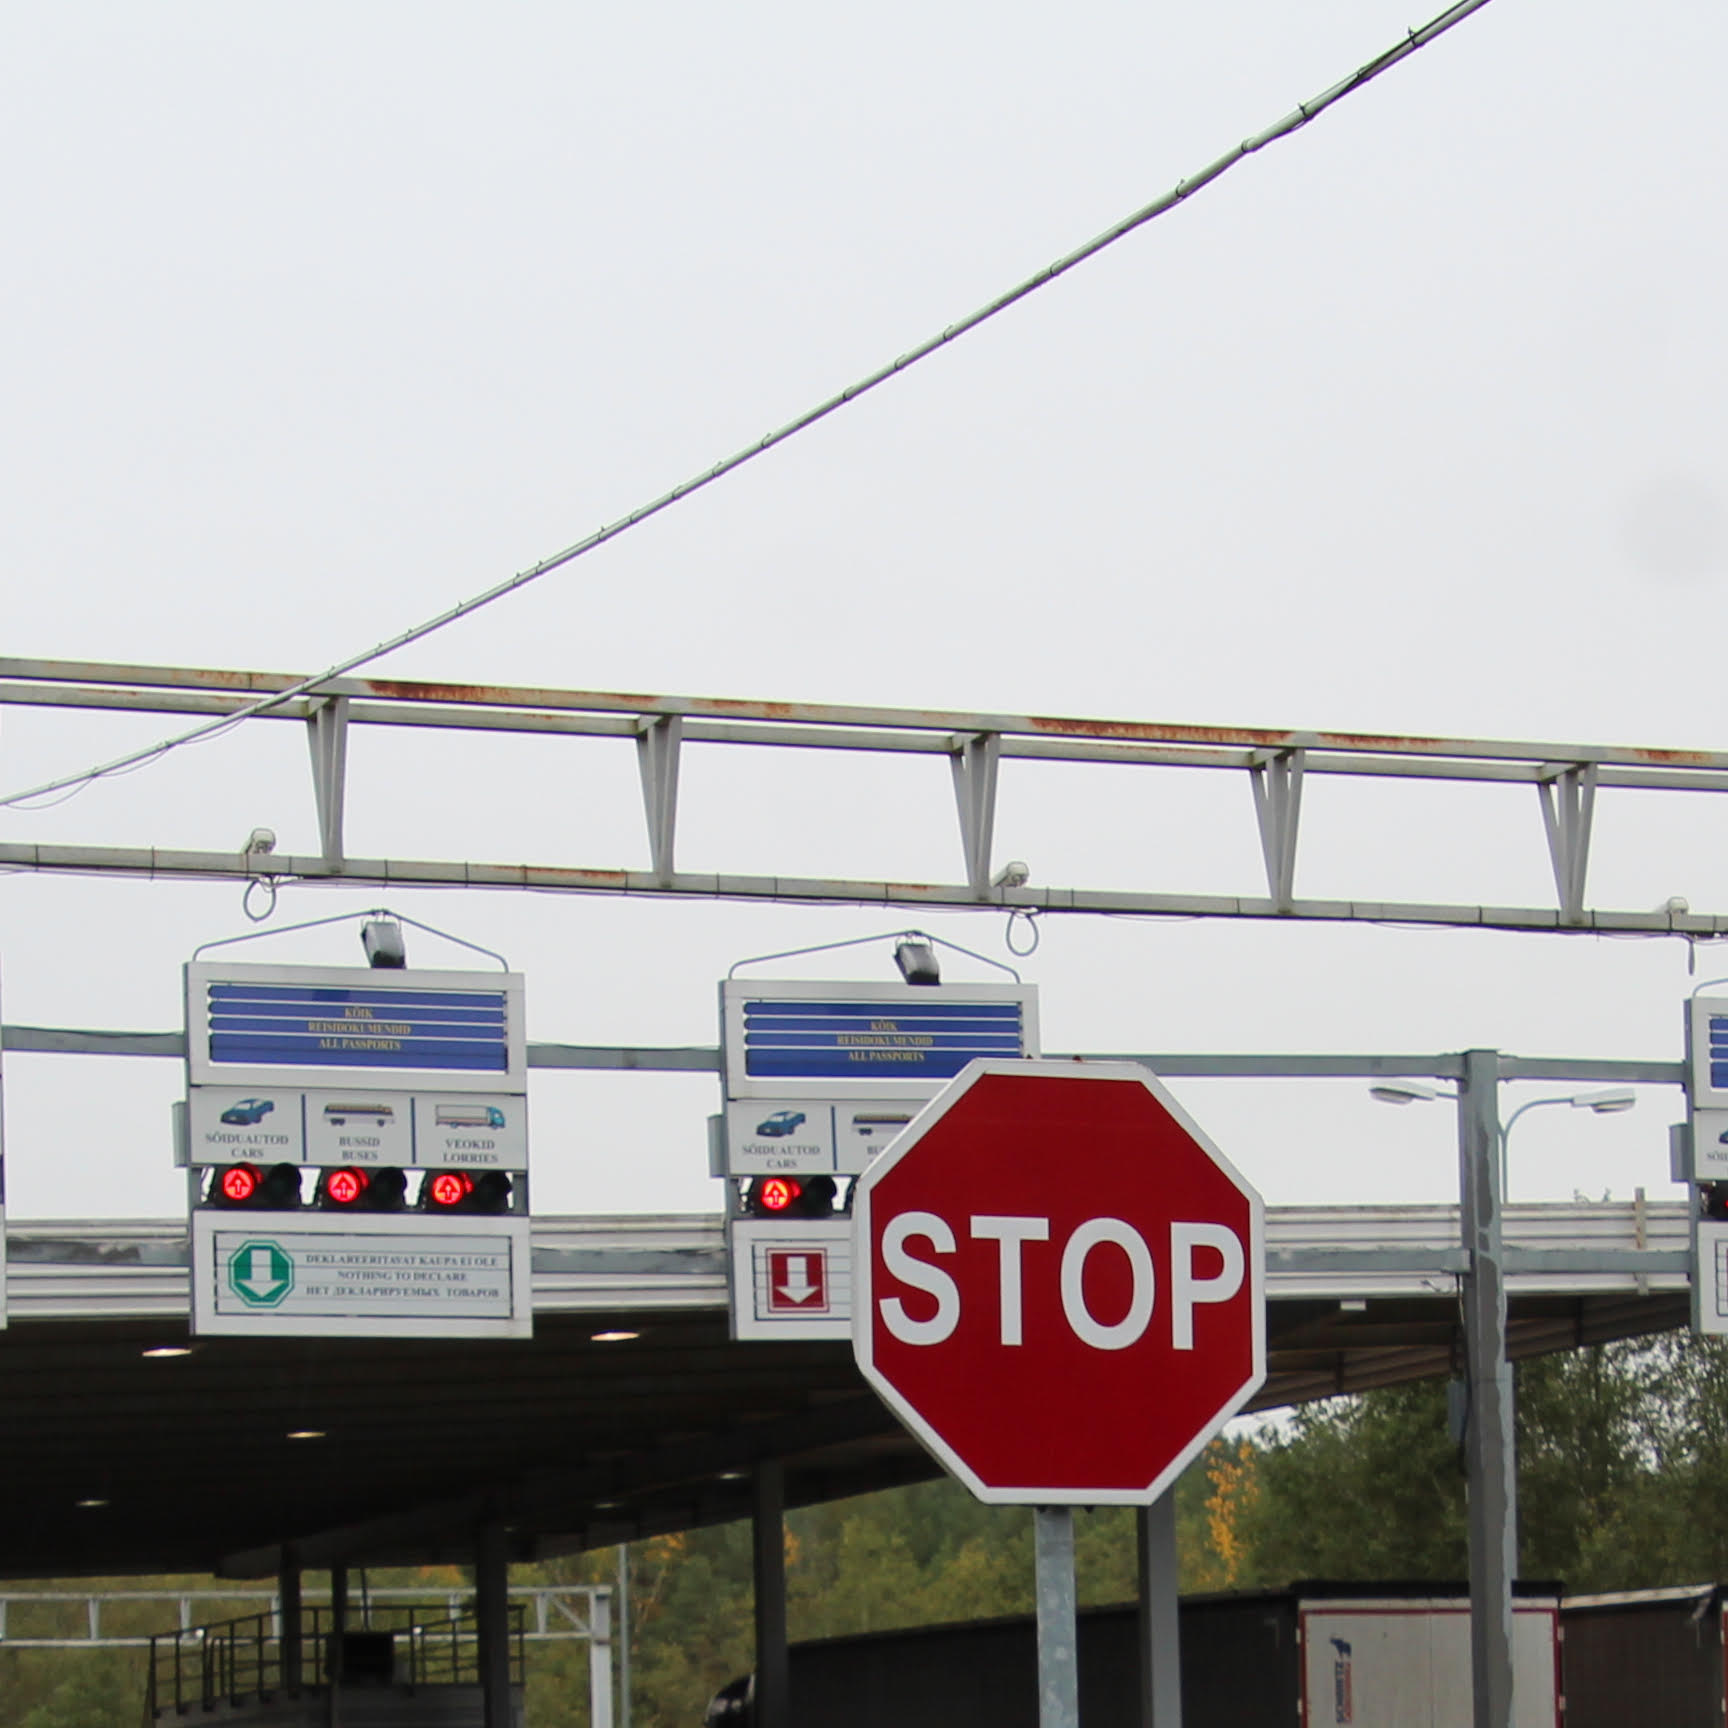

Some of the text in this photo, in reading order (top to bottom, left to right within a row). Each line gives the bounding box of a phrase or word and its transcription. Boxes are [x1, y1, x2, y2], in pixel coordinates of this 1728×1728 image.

[317, 1038, 401, 1051] ALL PASSPORTS
[848, 1051, 925, 1062] ALL PASSPORTS
[205, 1130, 289, 1146] SÕIDUAUTOD
[338, 1136, 380, 1147] BUSSID
[446, 1138, 495, 1150] VEOKID
[231, 1147, 264, 1159] CARS
[742, 1142, 820, 1156] SÕIDUAUTOD
[341, 1150, 378, 1161] BUSES
[442, 1152, 498, 1164] LORRIES
[766, 1159, 797, 1169] CARS
[306, 1254, 416, 1265] DEKLAREERITAVAT
[419, 1256, 459, 1266] KAUPA
[474, 1257, 498, 1267] OLE
[337, 1270, 468, 1282] NOTHING TO DECLARE
[879, 1211, 1245, 1351] STOP
